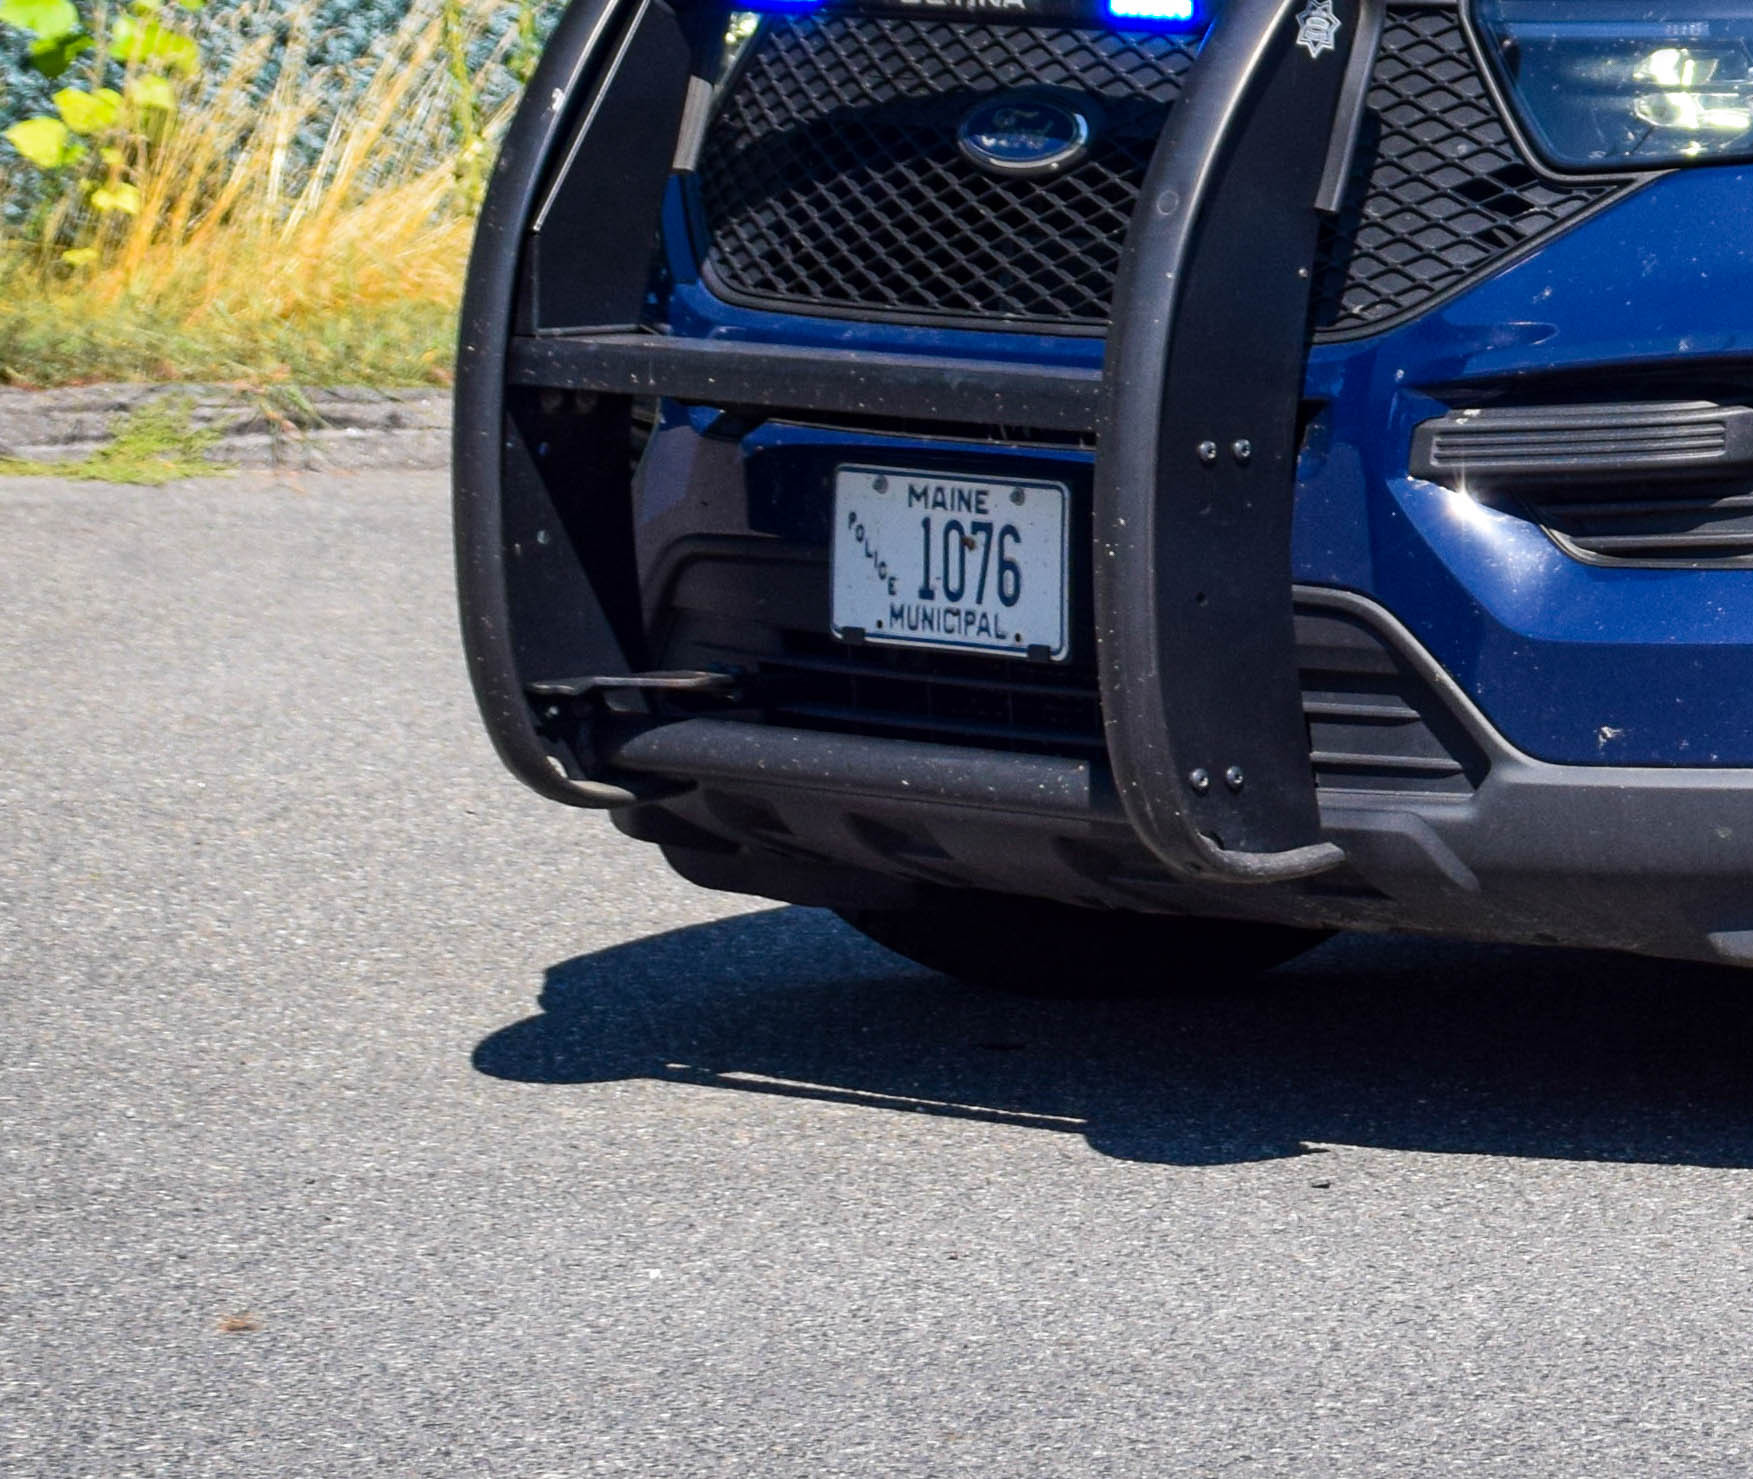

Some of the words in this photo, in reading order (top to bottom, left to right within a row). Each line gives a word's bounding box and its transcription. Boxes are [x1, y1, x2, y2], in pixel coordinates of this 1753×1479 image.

[908, 484, 989, 514] MAINE
[848, 512, 897, 596] POLICE
[918, 516, 1022, 608] 1076
[890, 605, 1007, 640] MUNICIPAL
